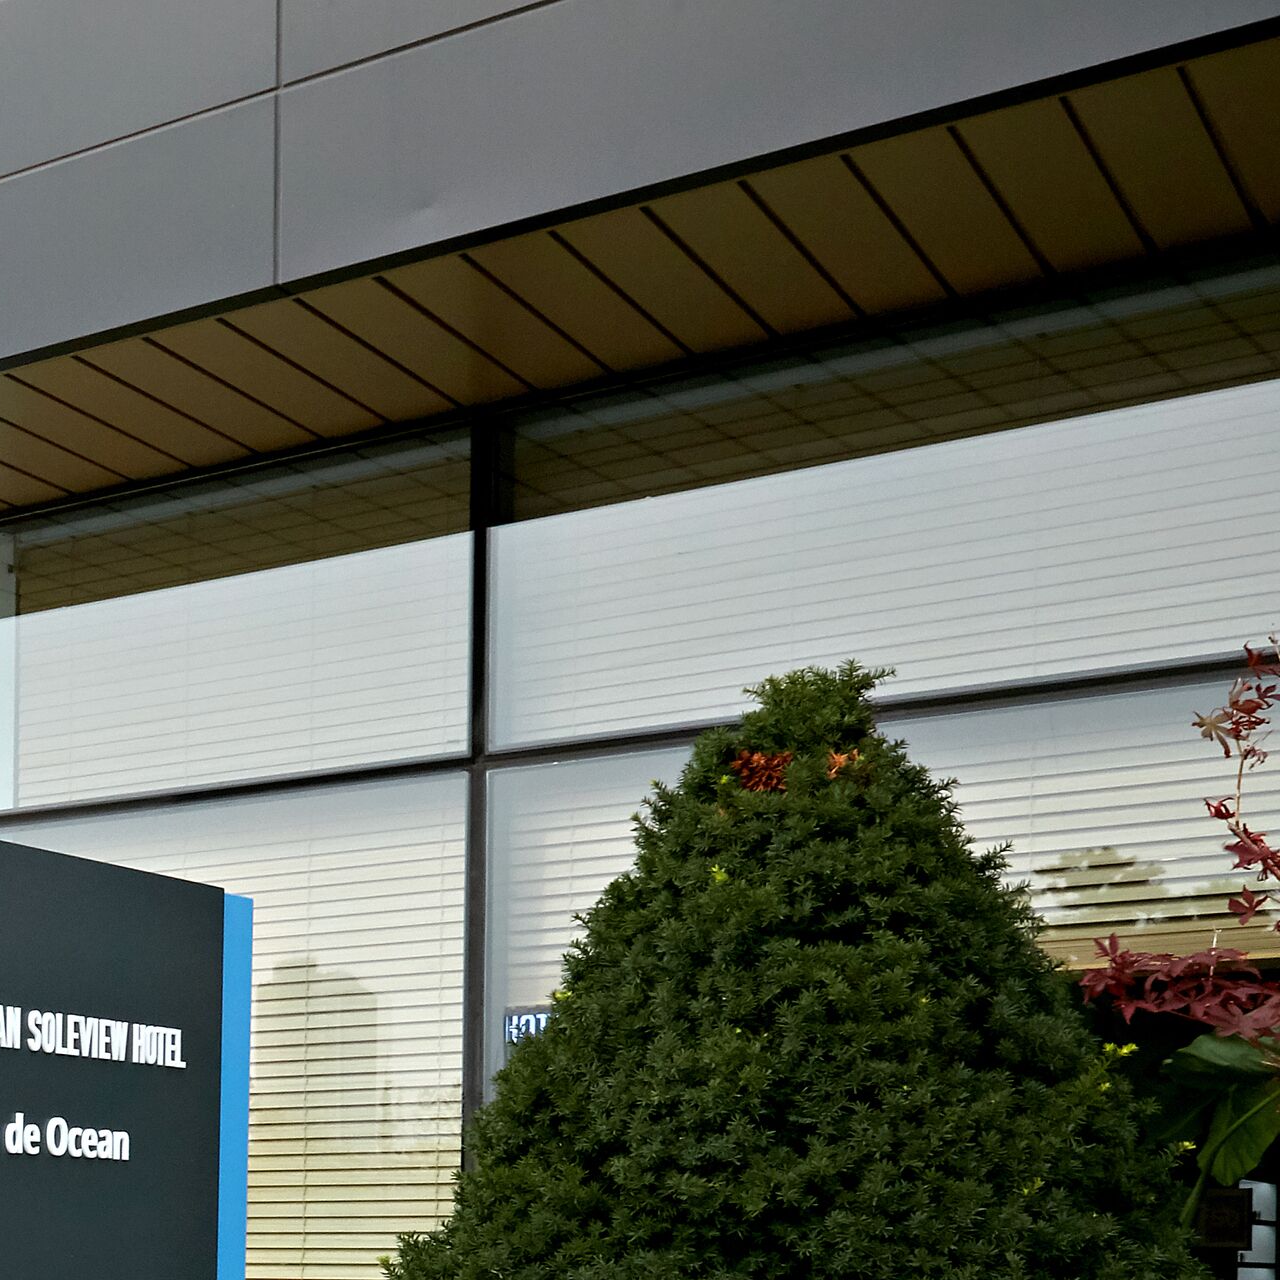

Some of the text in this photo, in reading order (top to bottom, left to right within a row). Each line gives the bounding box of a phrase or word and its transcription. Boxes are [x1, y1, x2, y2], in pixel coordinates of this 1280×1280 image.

[26, 1009, 130, 1062] SOLEVIEW
[131, 1022, 187, 1069] HOTEL
[4, 1111, 41, 1156] de
[45, 1115, 131, 1162] Ocean
